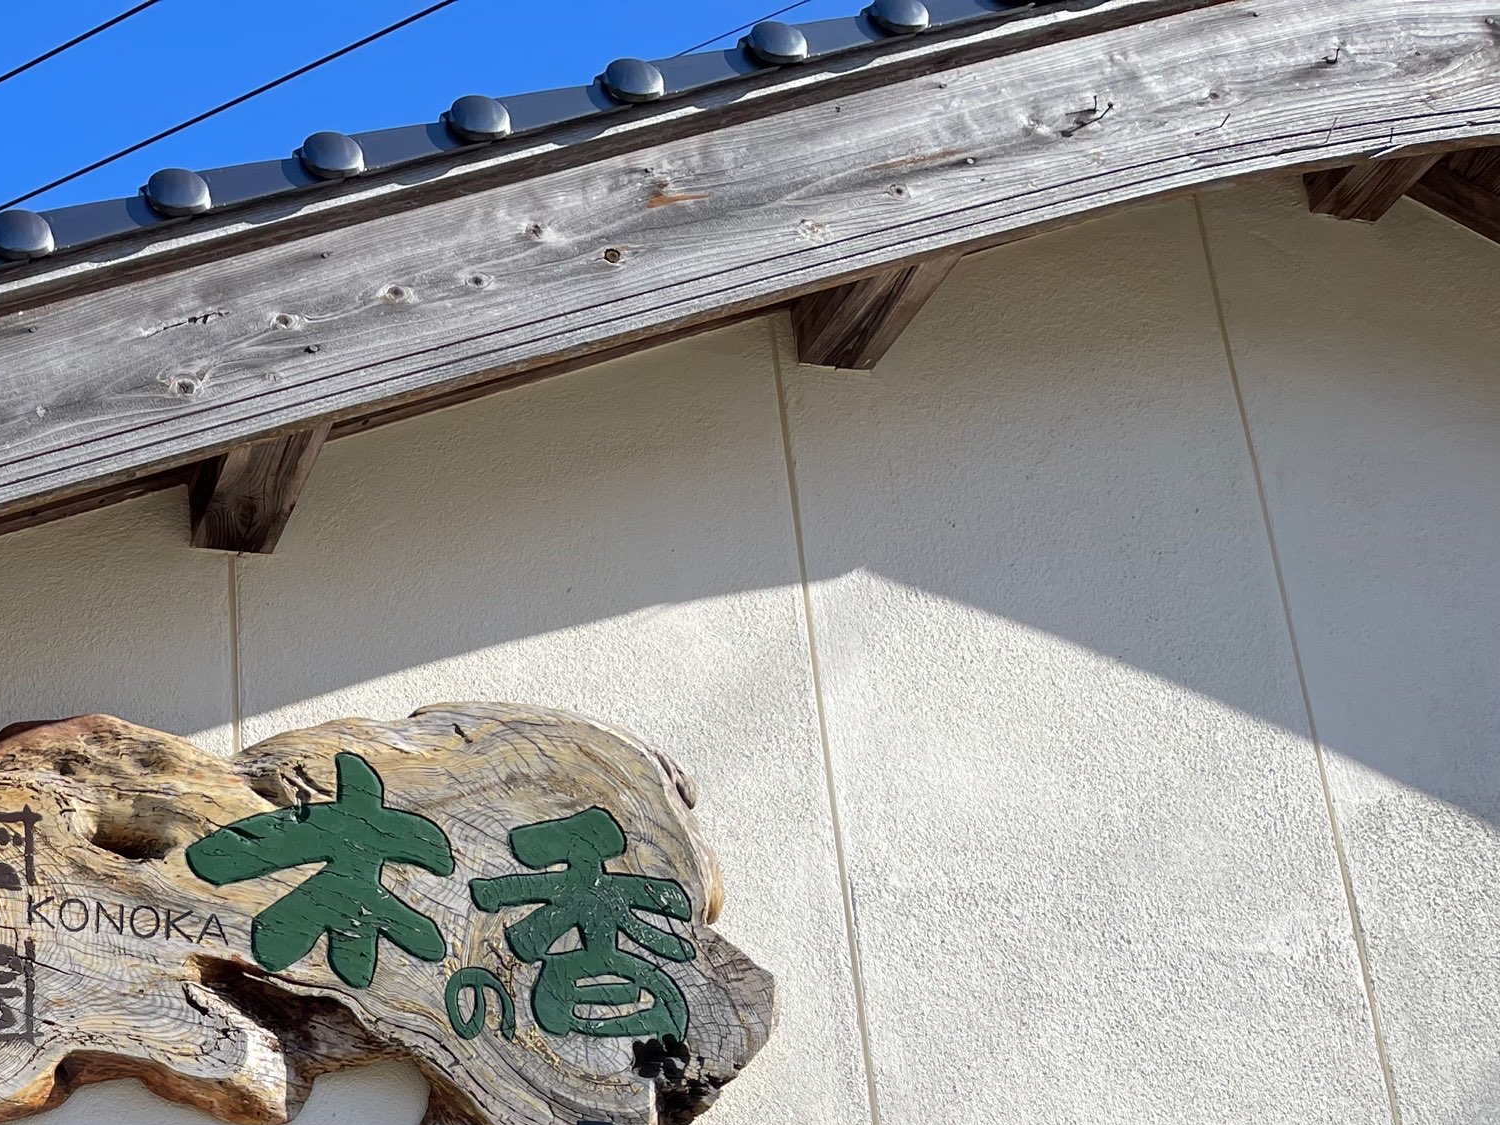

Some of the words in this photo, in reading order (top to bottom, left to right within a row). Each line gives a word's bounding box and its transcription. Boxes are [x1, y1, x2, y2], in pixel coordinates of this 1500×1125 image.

[26, 894, 229, 946] KONOKA
[186, 752, 697, 1040] 木の香
